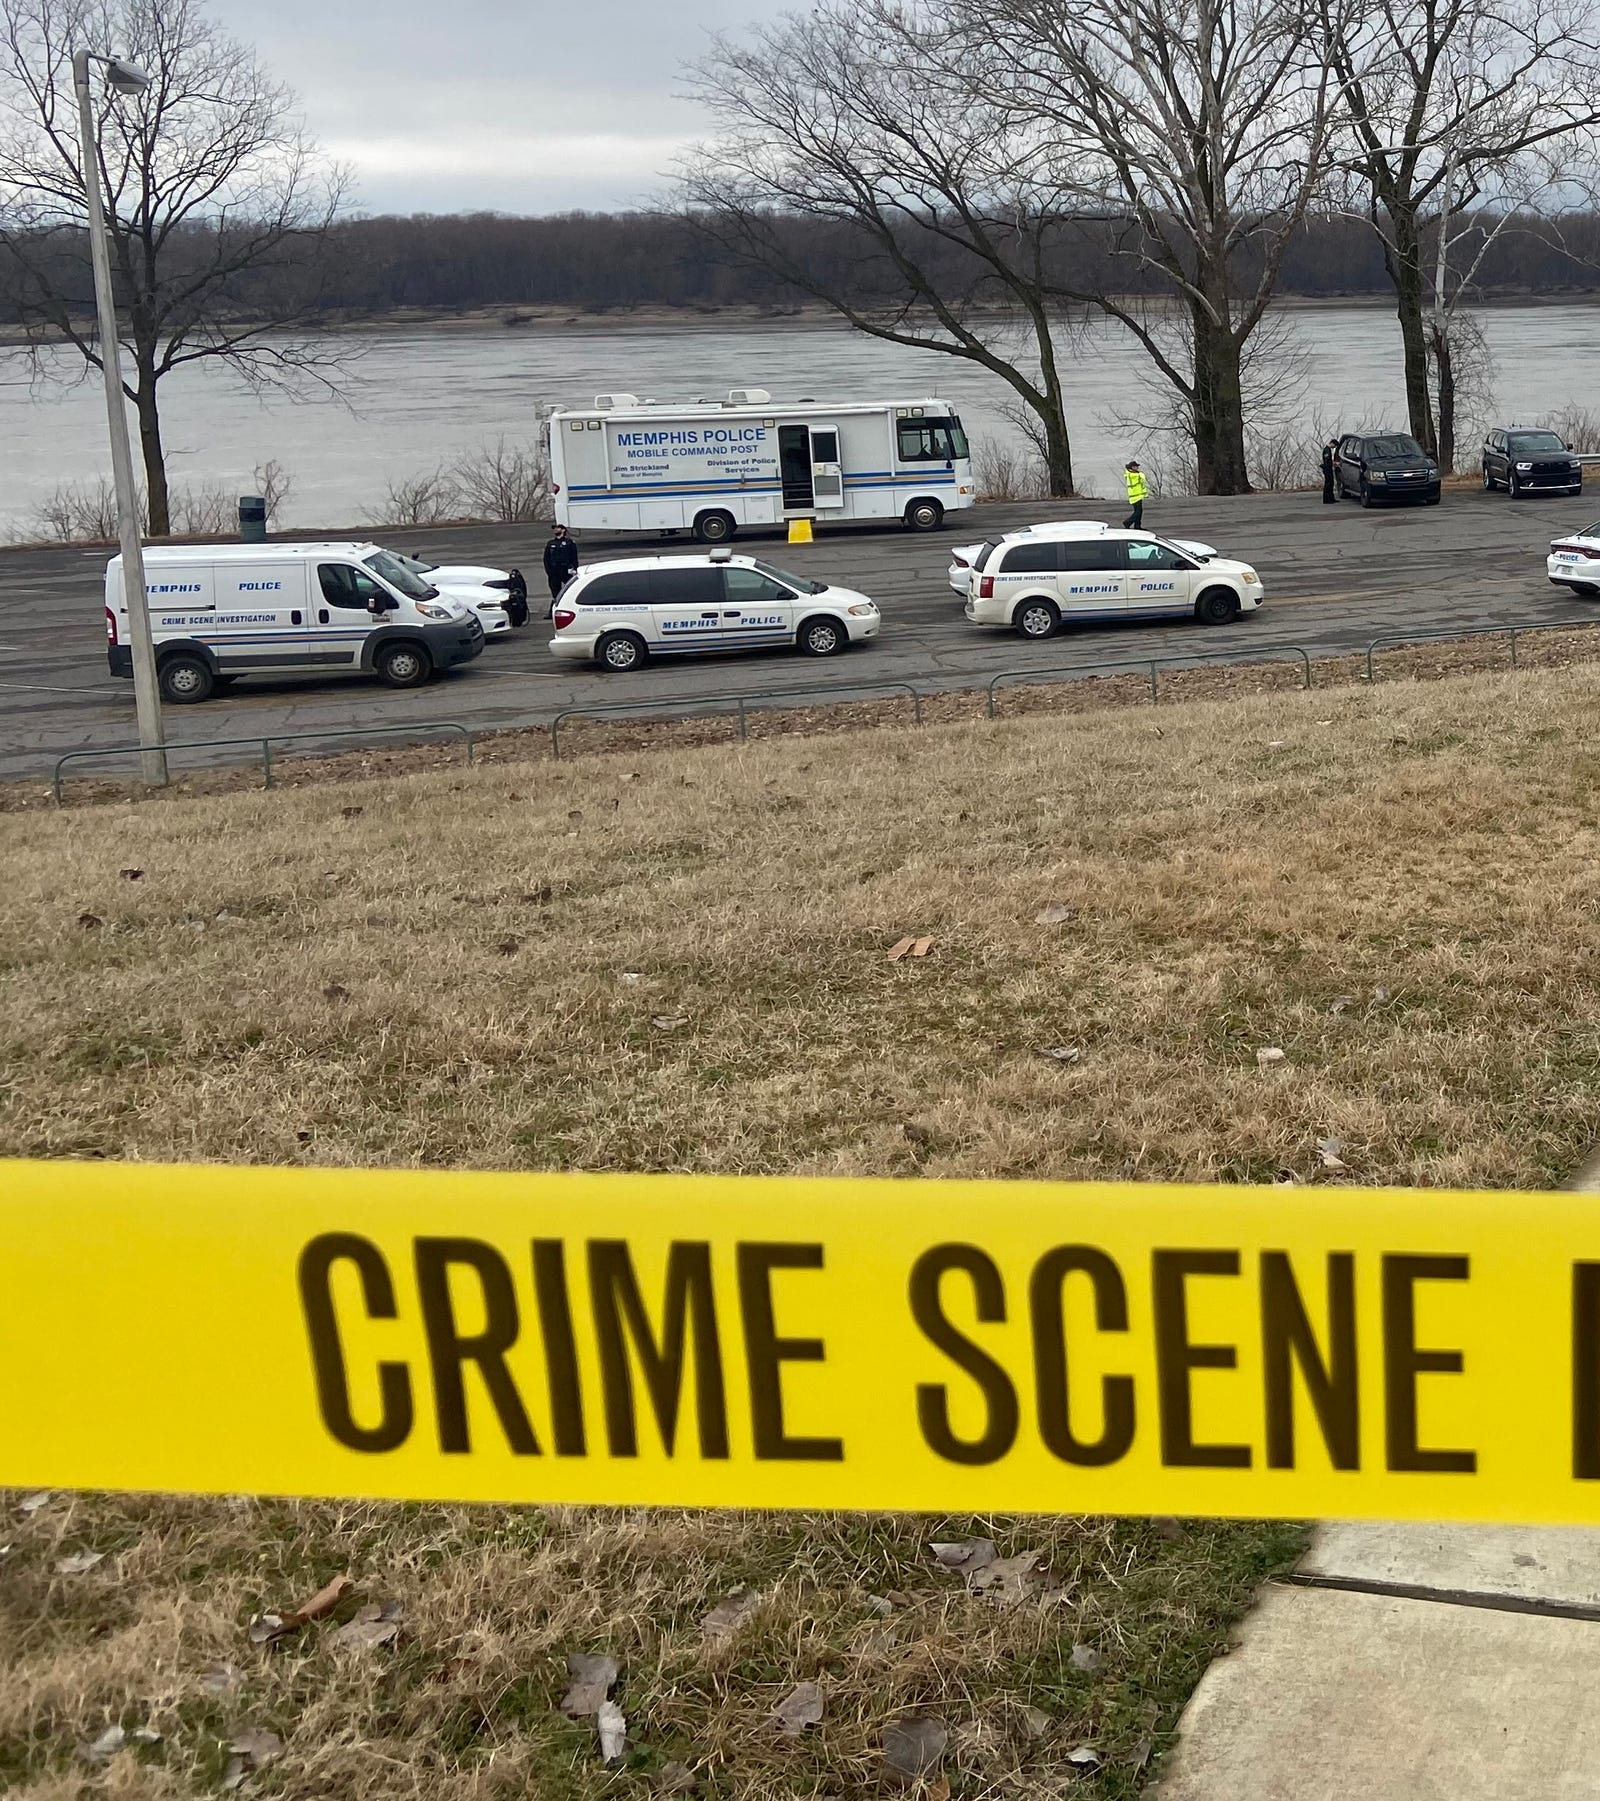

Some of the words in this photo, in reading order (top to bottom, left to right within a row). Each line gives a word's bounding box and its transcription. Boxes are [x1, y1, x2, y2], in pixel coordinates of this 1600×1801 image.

[617, 431, 698, 446] MEMPHIS
[703, 428, 766, 443] POLICE
[627, 448, 669, 458] MOBILE
[671, 446, 728, 457] COMMAND
[730, 445, 758, 454] POST
[613, 465, 628, 473] Jim
[629, 464, 670, 472] Strickland
[238, 582, 282, 590] POLICE
[1069, 585, 1119, 594] MEMPHIS
[1140, 582, 1175, 591] POLICE
[217, 615, 277, 623] INVESTIGATION
[662, 619, 718, 629] MEMPHIS
[740, 616, 784, 625] POLICE
[299, 1233, 844, 1462] CRIME
[908, 1244, 1477, 1473] SCENE
